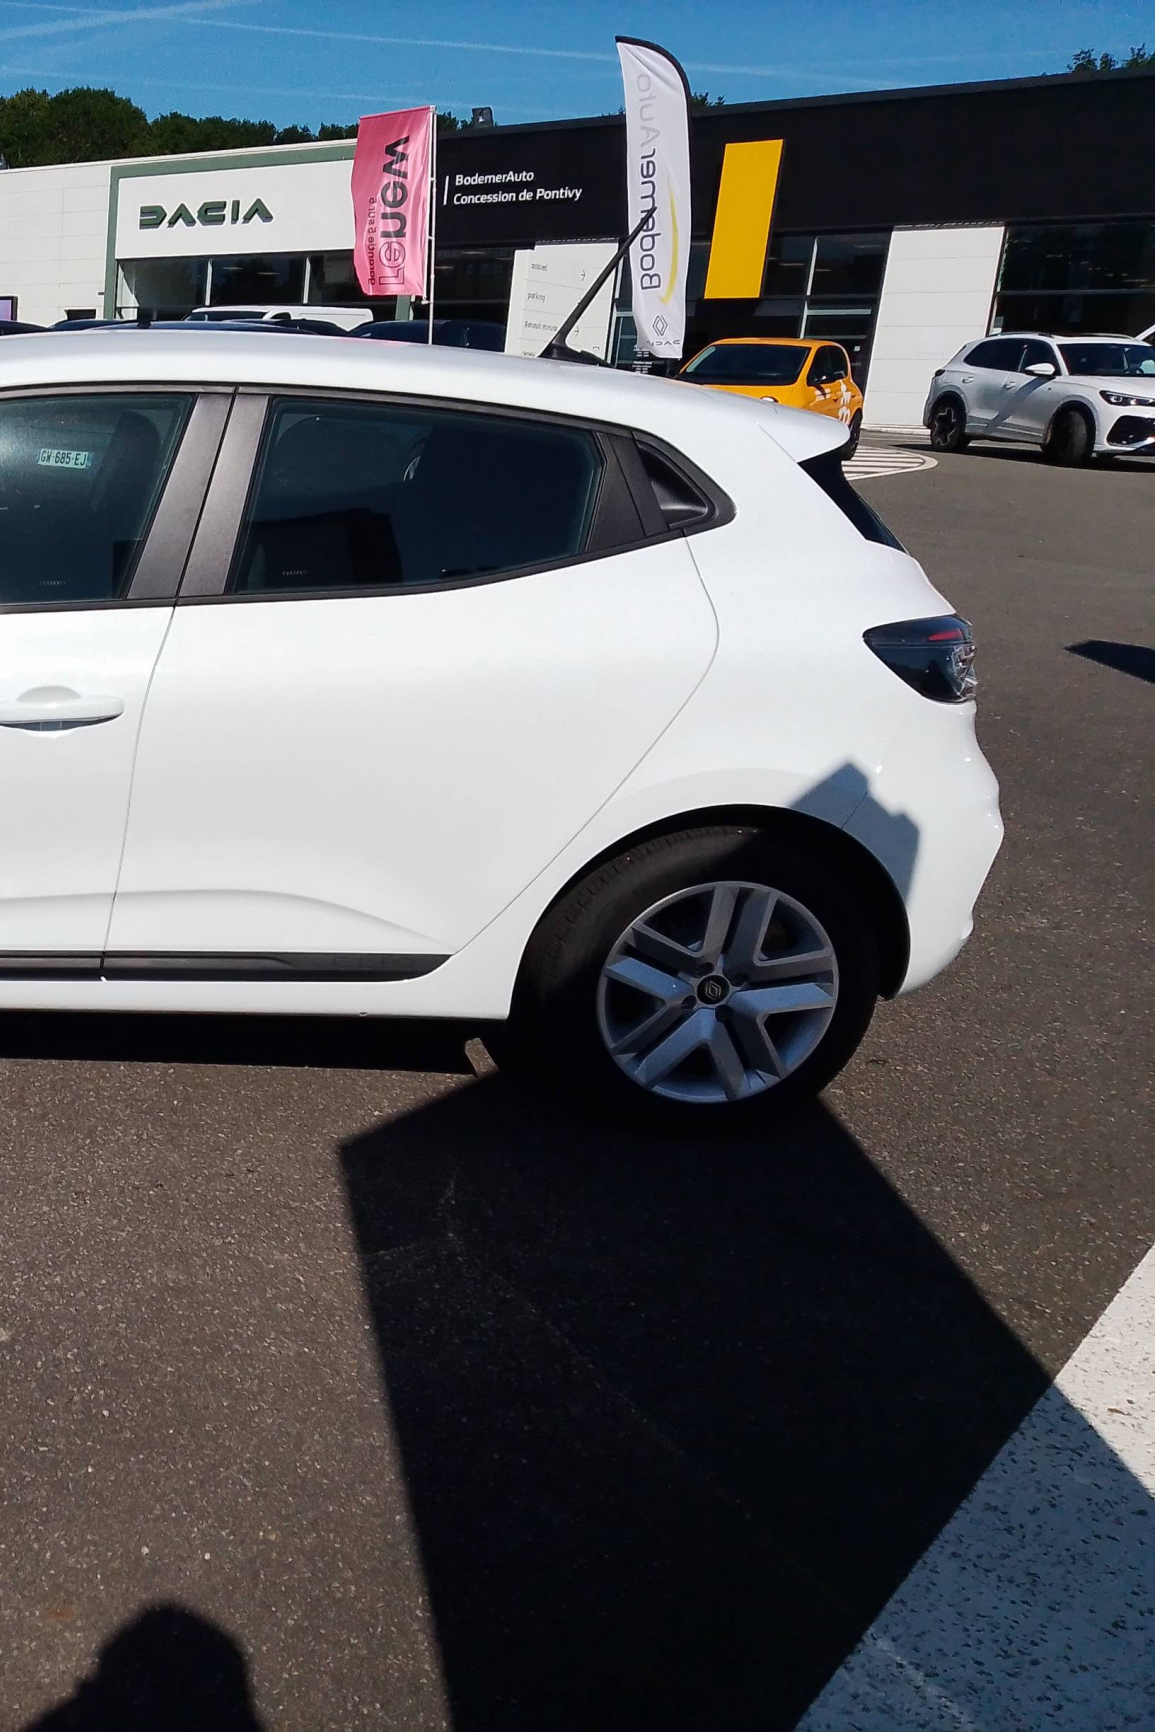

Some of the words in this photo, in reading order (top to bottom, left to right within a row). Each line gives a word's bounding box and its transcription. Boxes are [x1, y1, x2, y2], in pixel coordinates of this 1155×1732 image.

[455, 171, 535, 186] BodemerAuto
[453, 190, 516, 205] Concession
[518, 189, 533, 201] de
[536, 186, 582, 201] Pontivy
[139, 198, 273, 230] DACIA
[527, 292, 546, 303] parking
